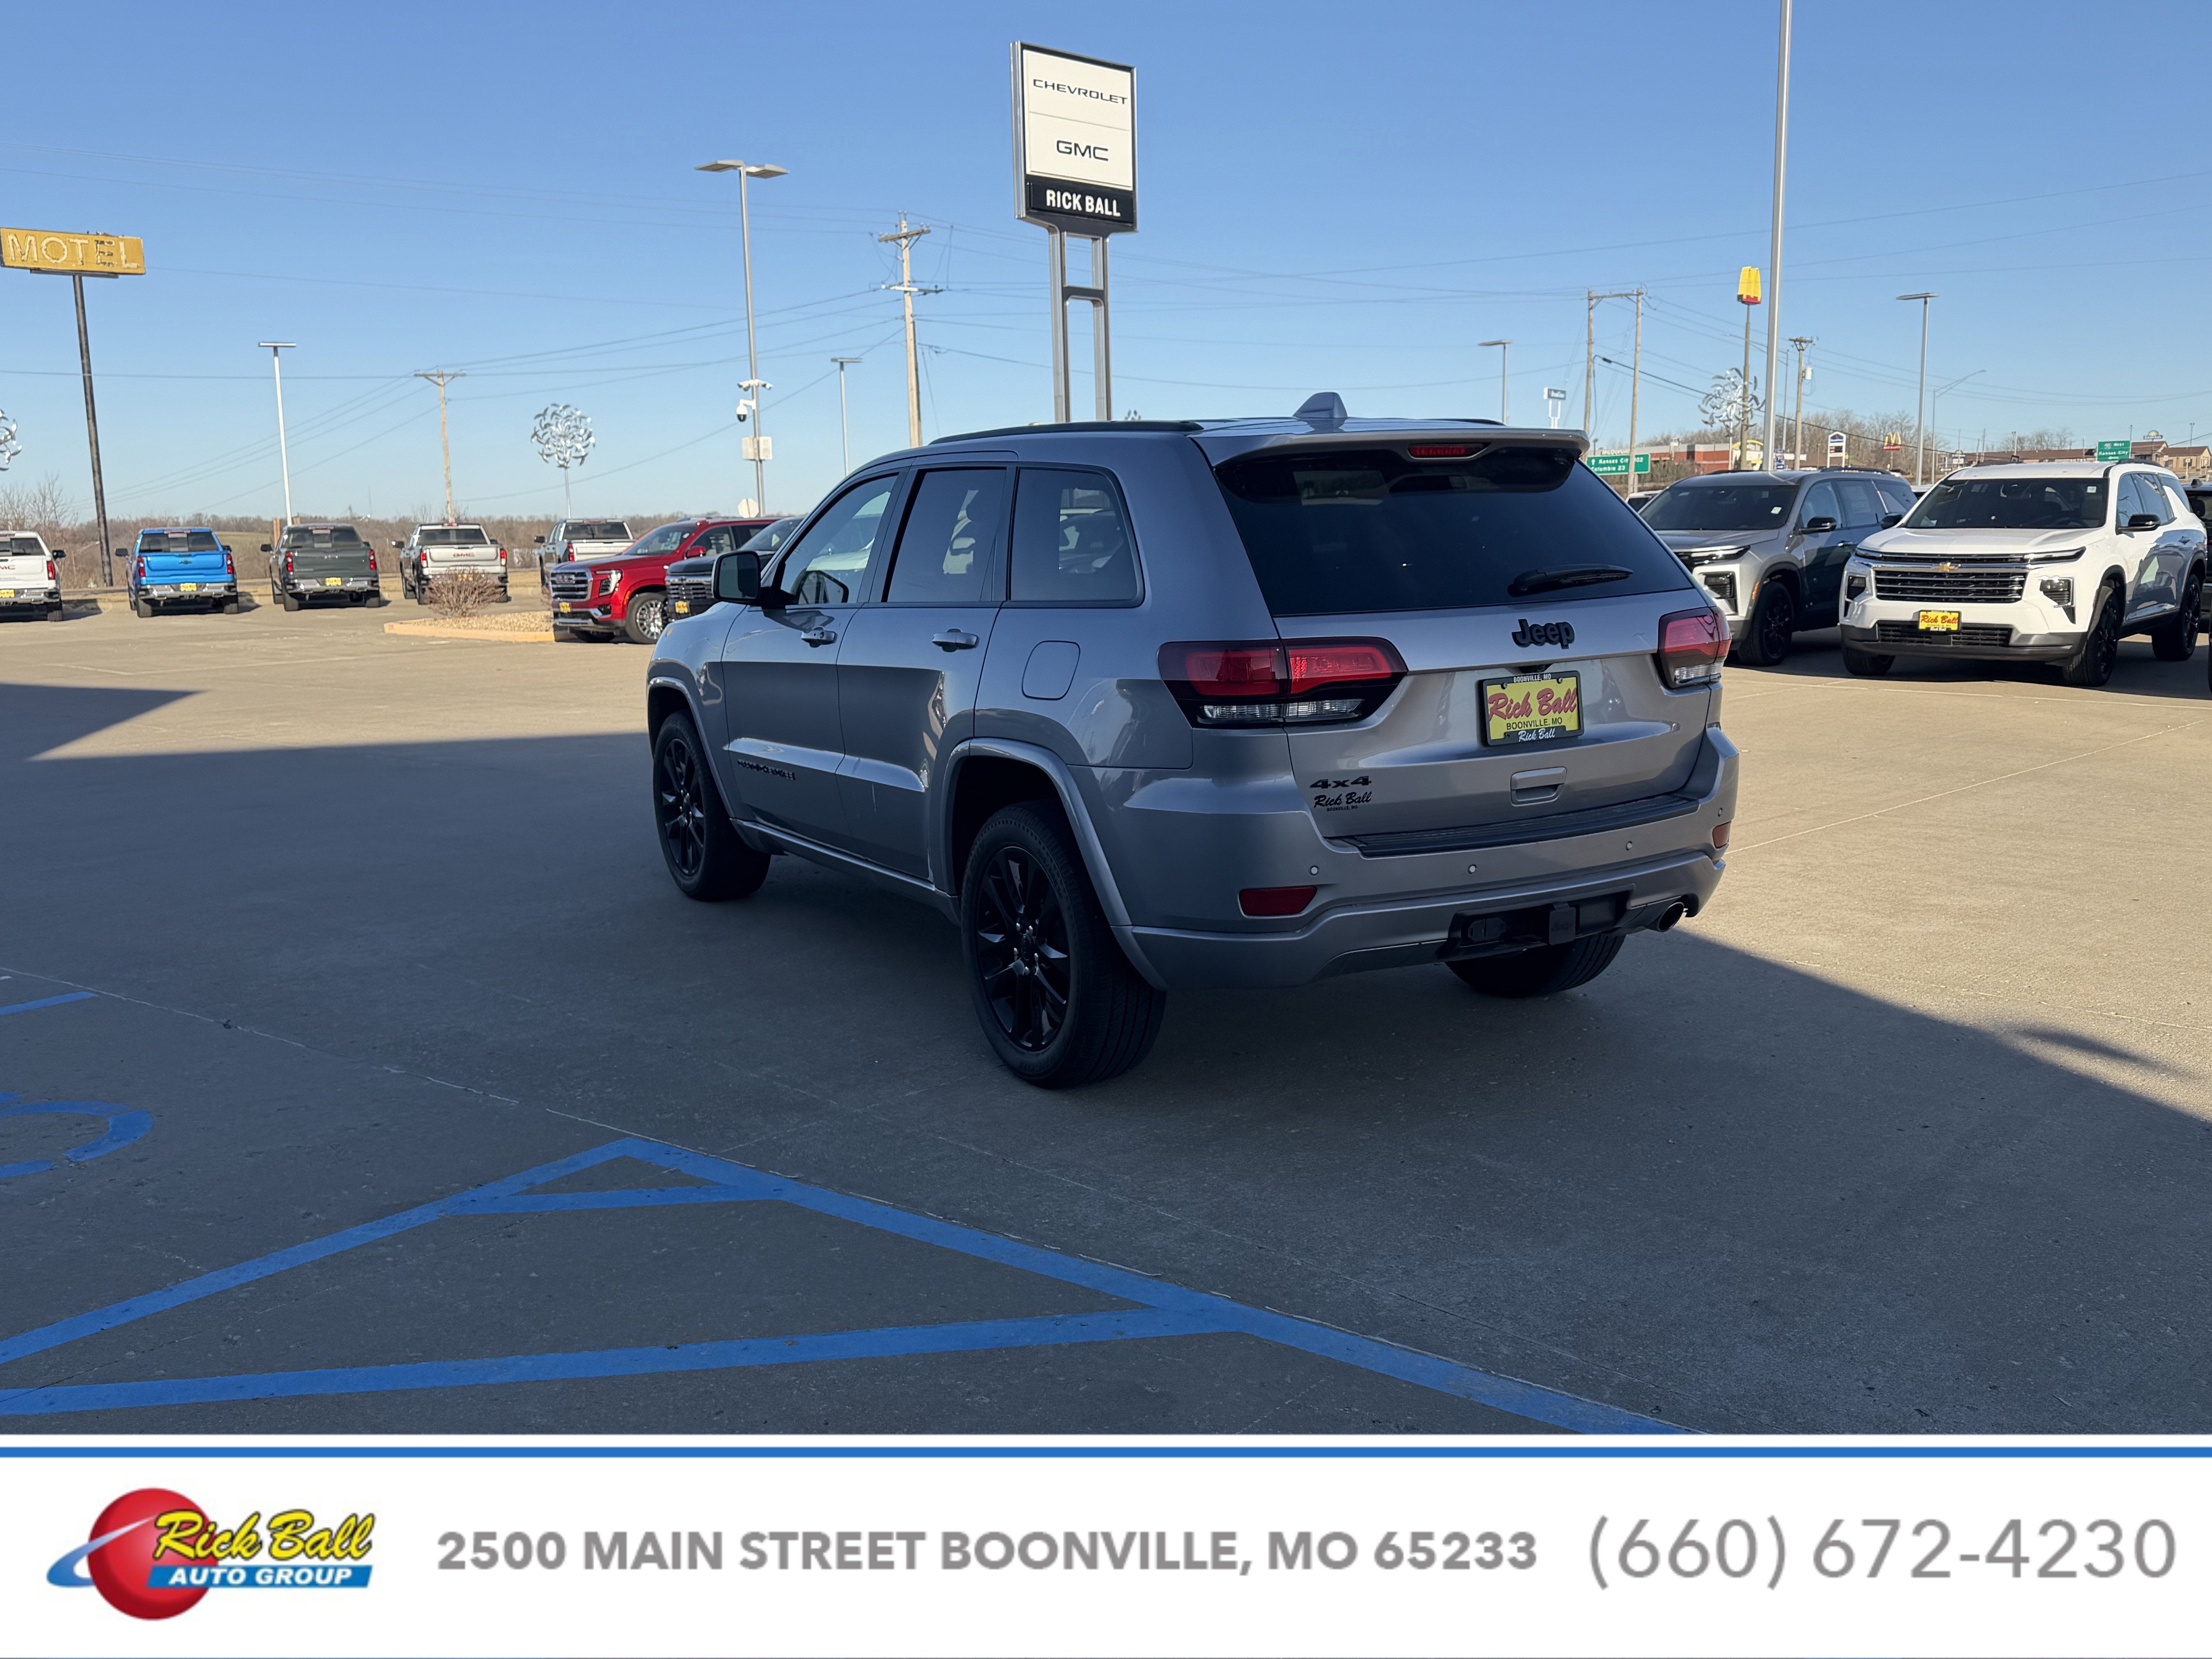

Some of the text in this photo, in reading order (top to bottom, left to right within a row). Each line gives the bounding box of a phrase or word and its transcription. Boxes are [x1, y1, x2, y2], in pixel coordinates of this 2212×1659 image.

[1033, 79, 1128, 105] CHEVROLET
[1056, 140, 1109, 161] GMC
[1046, 189, 1121, 217] RICK BALL
[7, 233, 141, 269] MOTEL
[1920, 615, 1958, 623] Rick Ball
[1511, 618, 1575, 649] Jeep
[1488, 687, 1577, 721] Rick Ball
[1552, 717, 1563, 725] MO
[1518, 728, 1555, 742] Rick Ball
[1310, 776, 1372, 789] 4x4
[1314, 791, 1372, 808] Rick Ball
